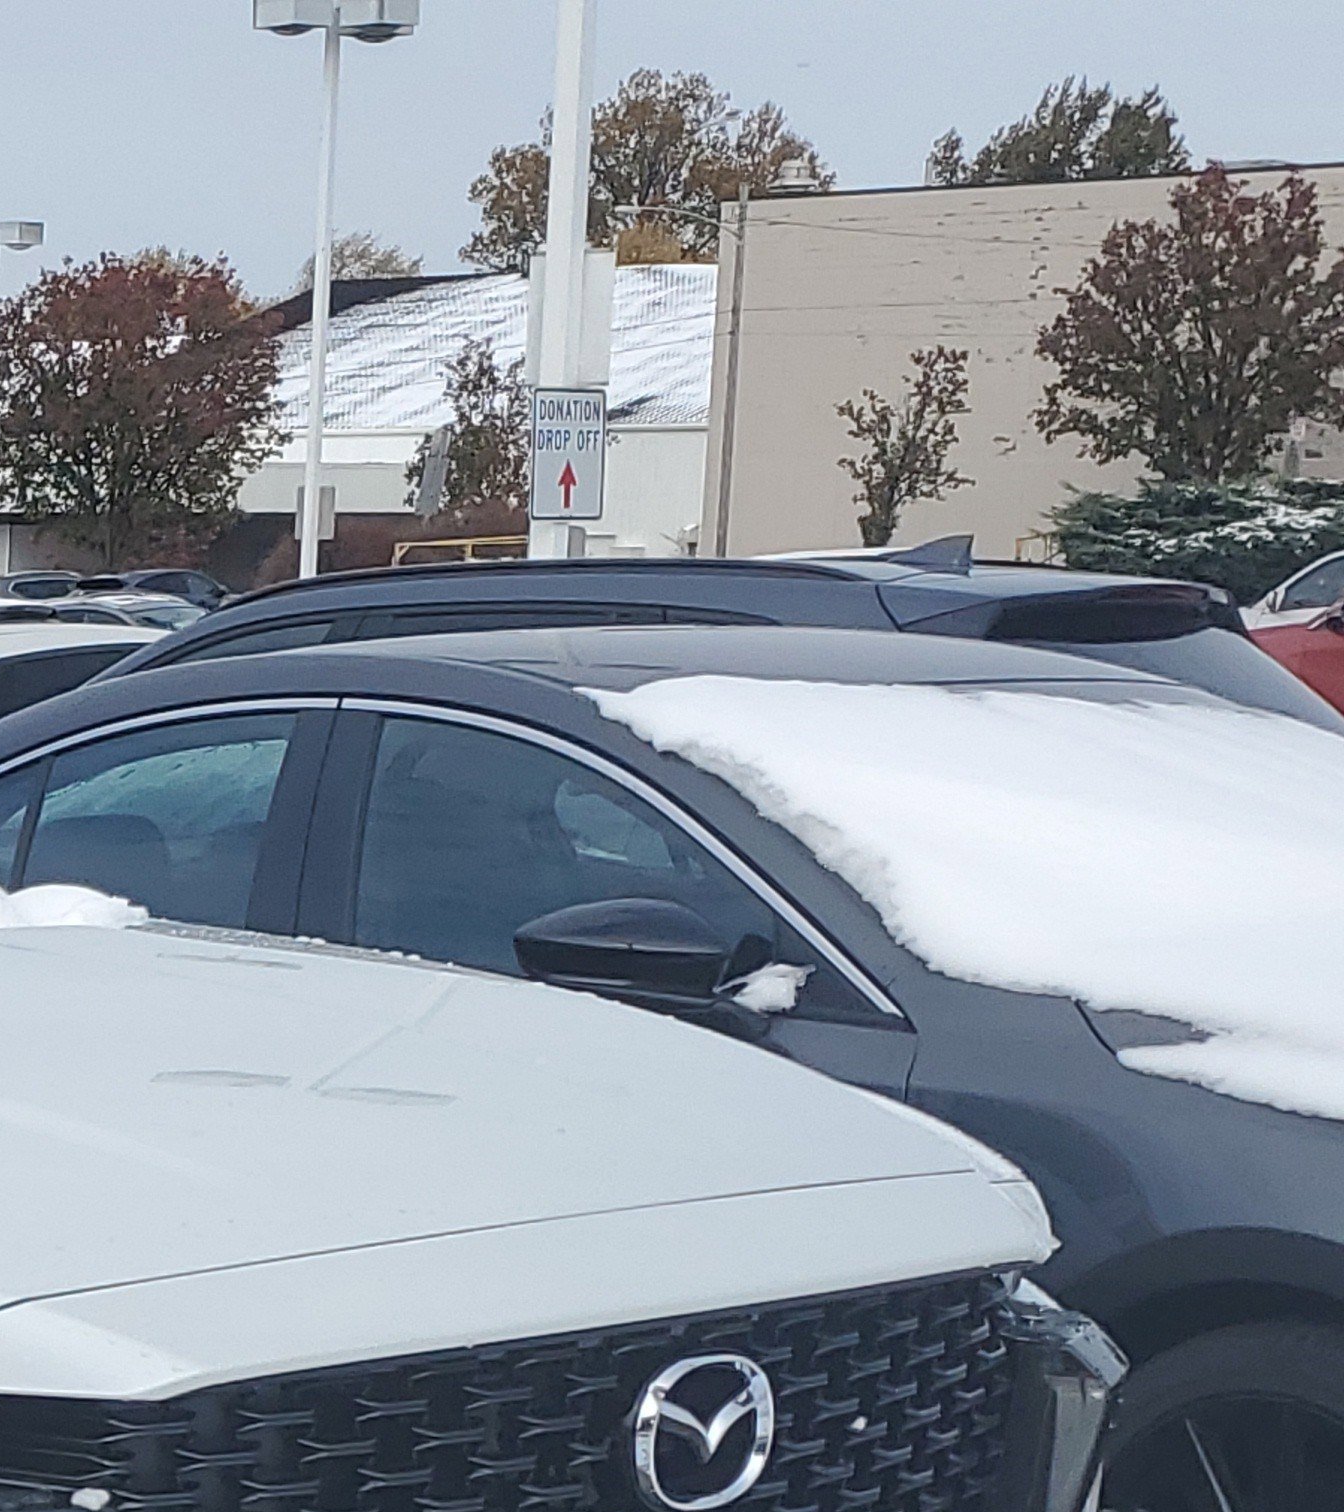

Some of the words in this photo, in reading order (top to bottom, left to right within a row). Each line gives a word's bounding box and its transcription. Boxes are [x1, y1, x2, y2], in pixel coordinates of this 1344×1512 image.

[538, 399, 601, 422] DONATION
[537, 429, 571, 450] DROP
[576, 429, 600, 451] OFF
